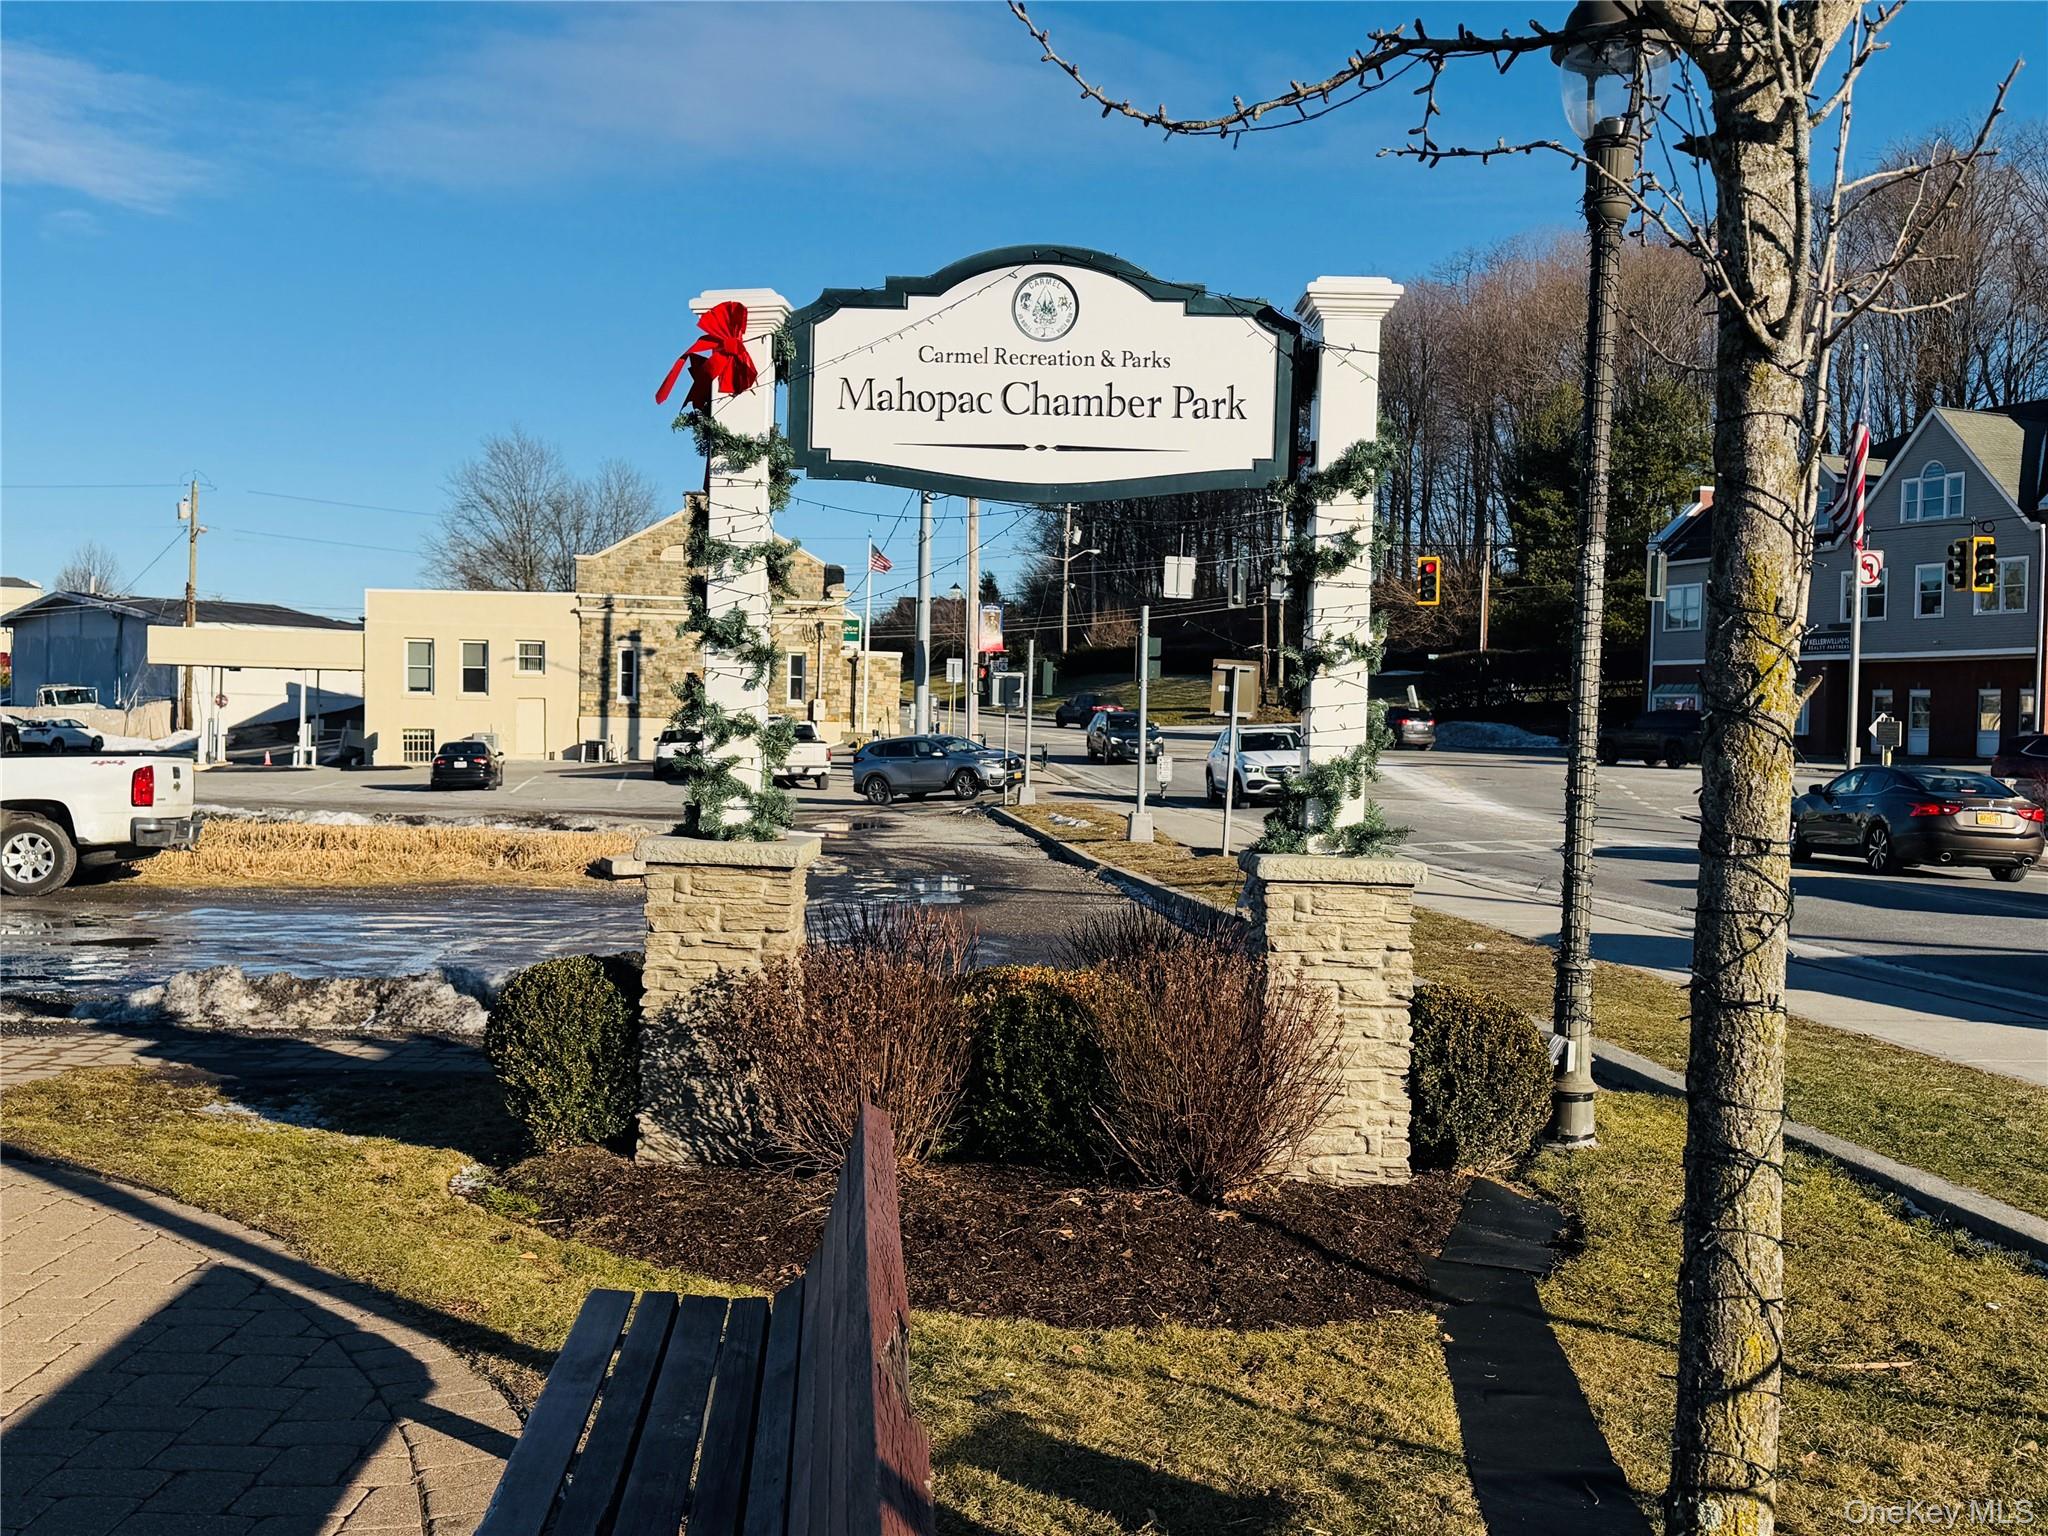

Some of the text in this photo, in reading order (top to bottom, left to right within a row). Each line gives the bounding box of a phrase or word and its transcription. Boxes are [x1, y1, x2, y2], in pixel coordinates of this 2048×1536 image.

[1028, 278, 1061, 290] CARMEL
[918, 345, 1171, 369] Carmel Recreation & Parks
[837, 376, 1248, 421] Mahopac Chamber Park
